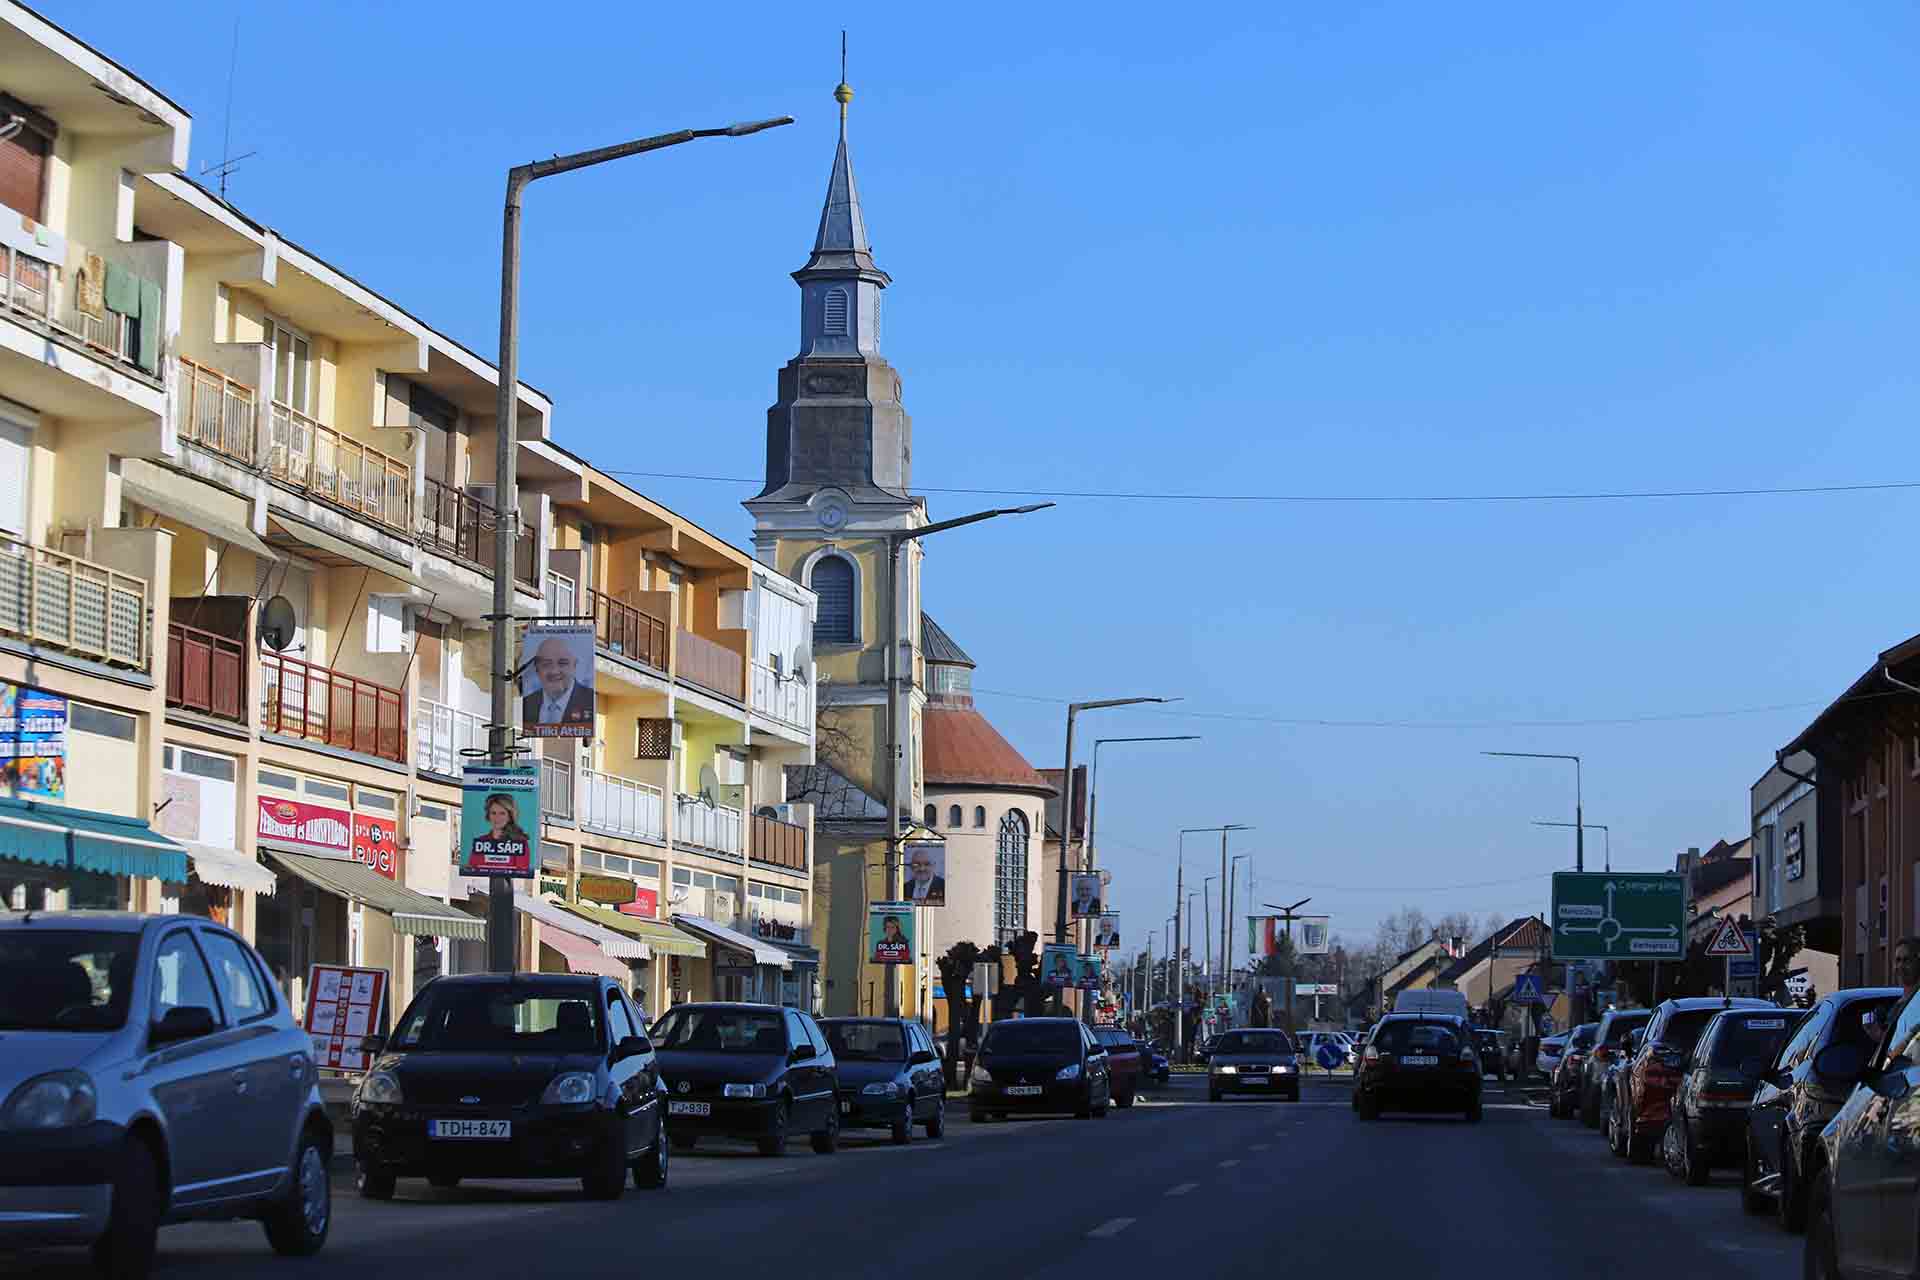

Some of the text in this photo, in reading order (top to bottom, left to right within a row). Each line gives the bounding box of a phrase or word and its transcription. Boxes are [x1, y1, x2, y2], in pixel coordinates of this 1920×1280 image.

[535, 726, 558, 736] Tilki
[560, 726, 592, 736] Attila
[478, 776, 535, 786] MAGYARORSZÁG
[475, 841, 524, 854] DR. SÁPI
[439, 1121, 507, 1136] TDH-847
